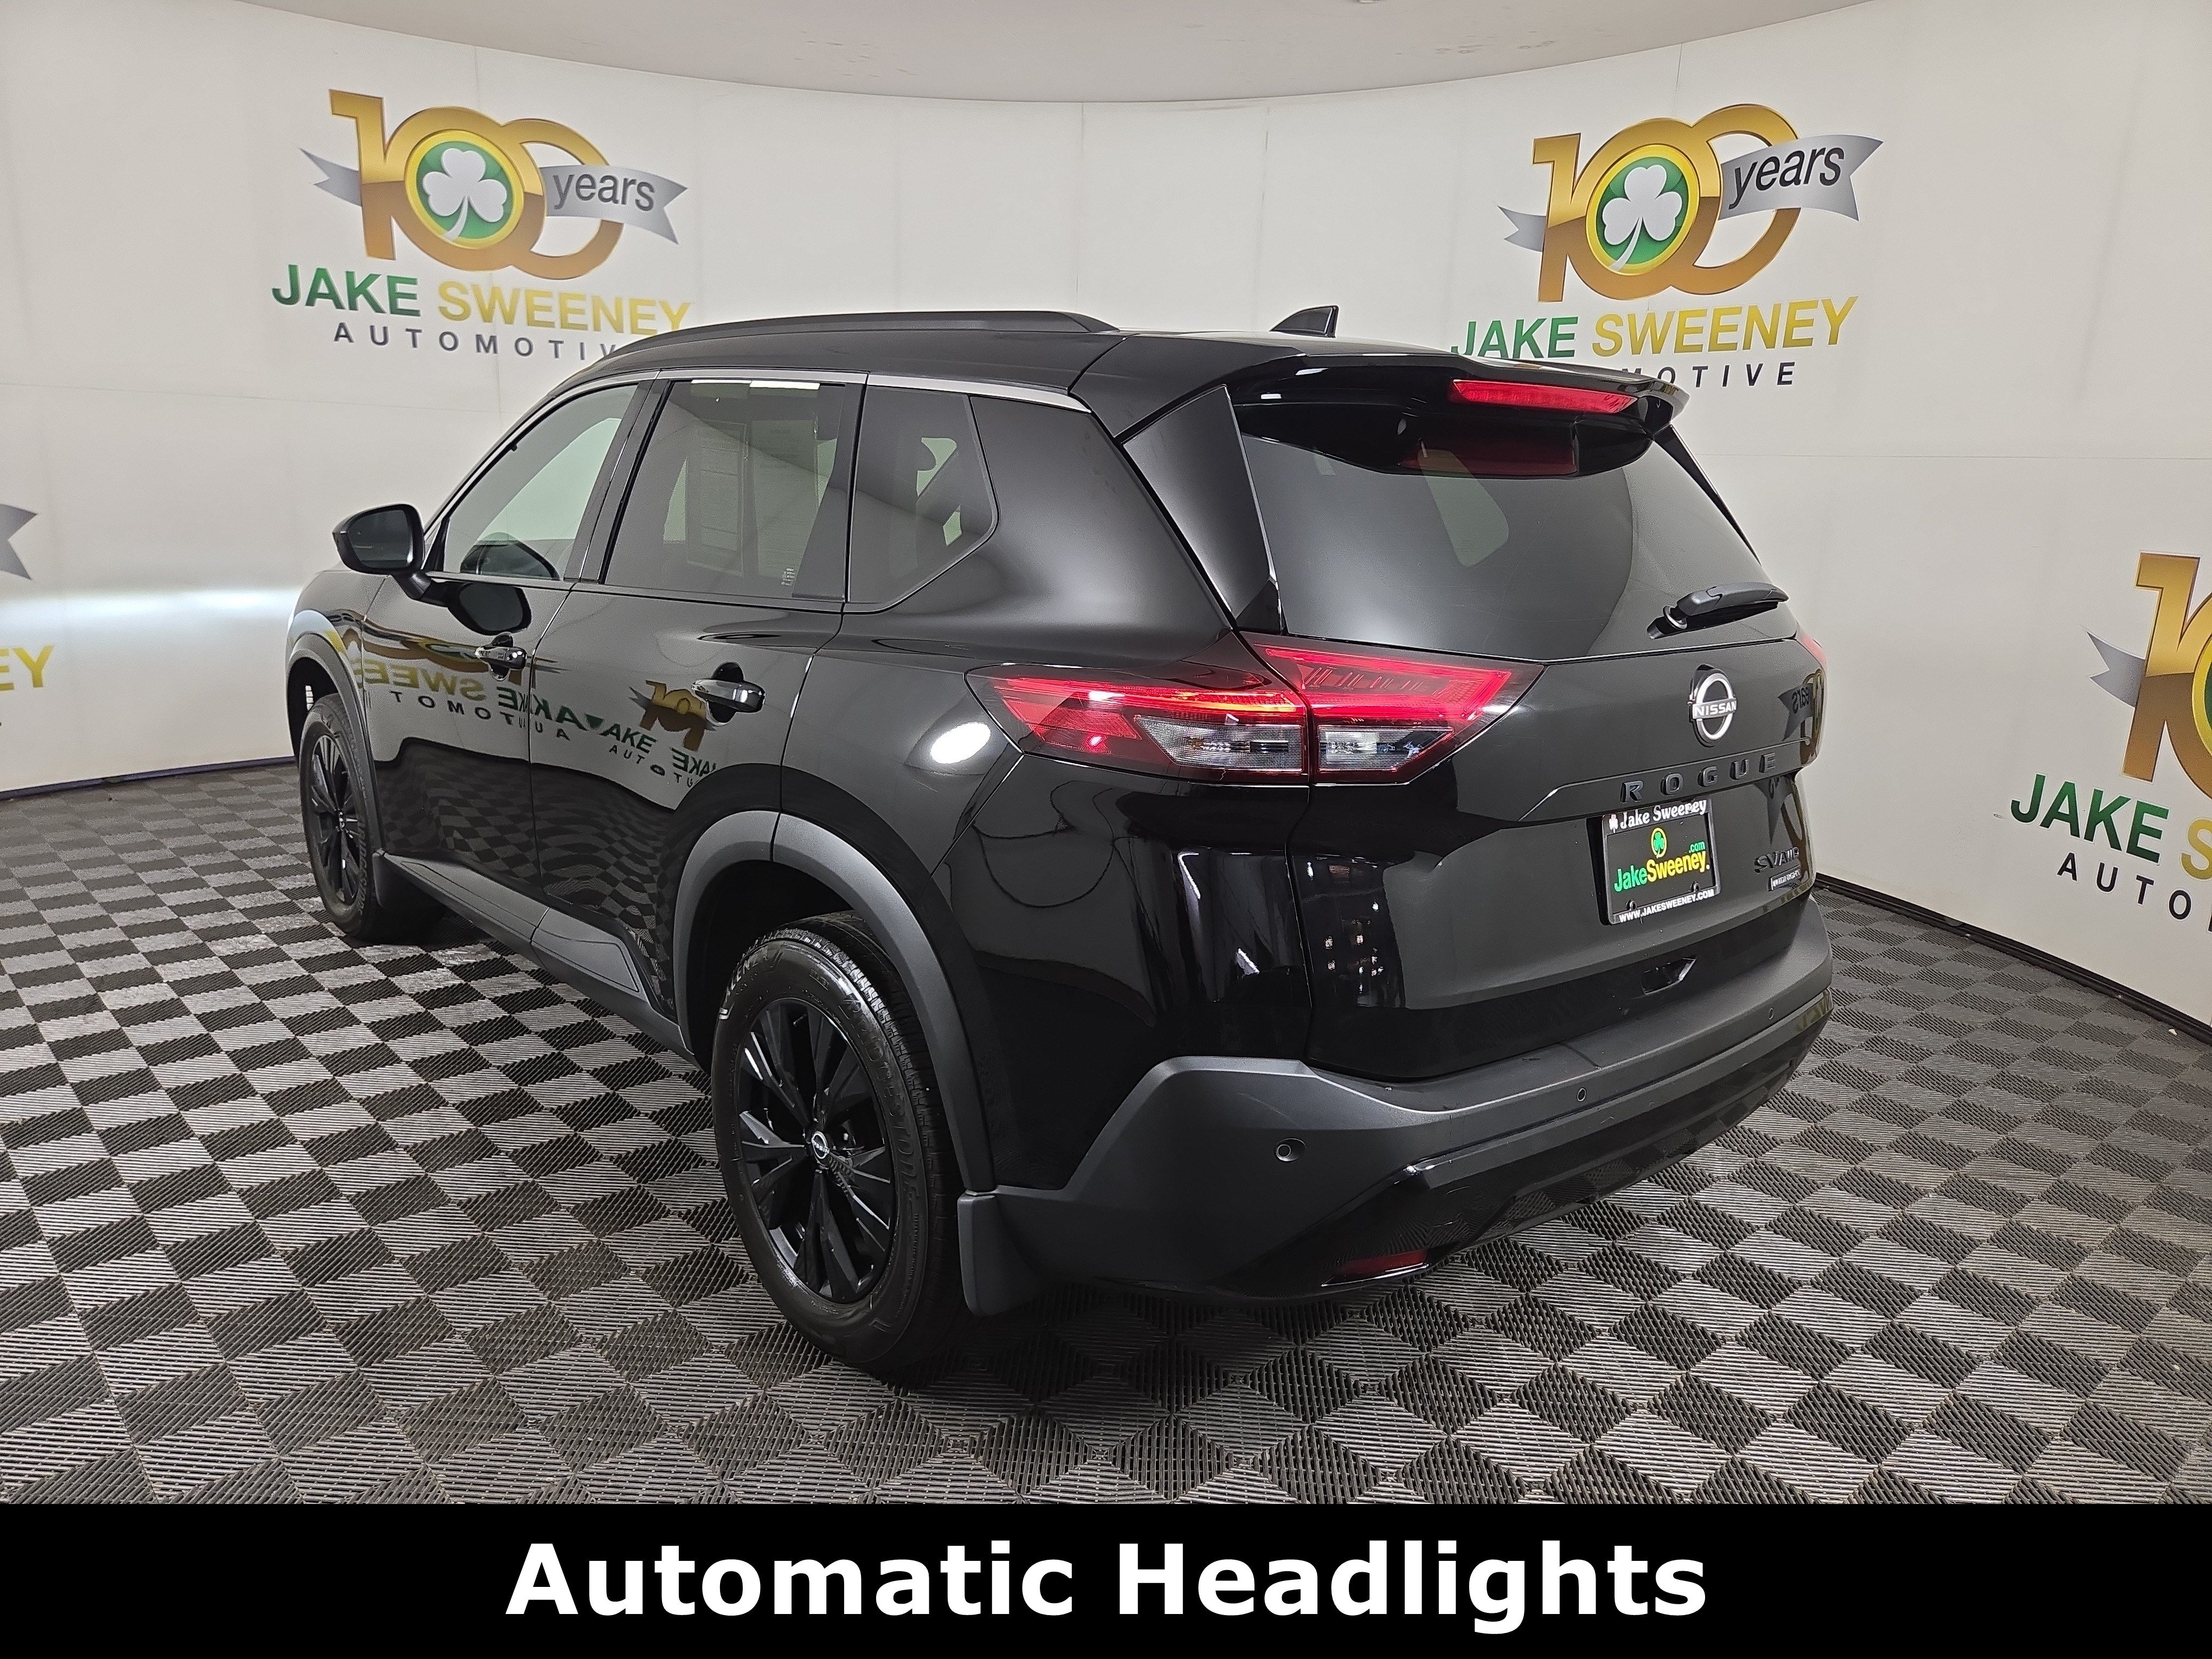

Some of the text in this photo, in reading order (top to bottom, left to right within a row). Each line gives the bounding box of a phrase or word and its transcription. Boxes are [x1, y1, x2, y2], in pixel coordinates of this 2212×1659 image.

[552, 171, 656, 213] years
[1728, 145, 1844, 210] years
[272, 264, 691, 336] JAKE SWEENEY
[1450, 295, 1860, 359] JAKE SWEENEY
[1622, 362, 1796, 388] OTIVE
[1693, 700, 1737, 720] NISSAN
[1620, 751, 1776, 803] ROGUE
[1620, 799, 1707, 829] Jake Sweeney
[2010, 772, 2169, 865] JAKE
[1618, 888, 1715, 923] WWW.JAKESWEENEY.COM
[2057, 852, 2212, 933] AUTO
